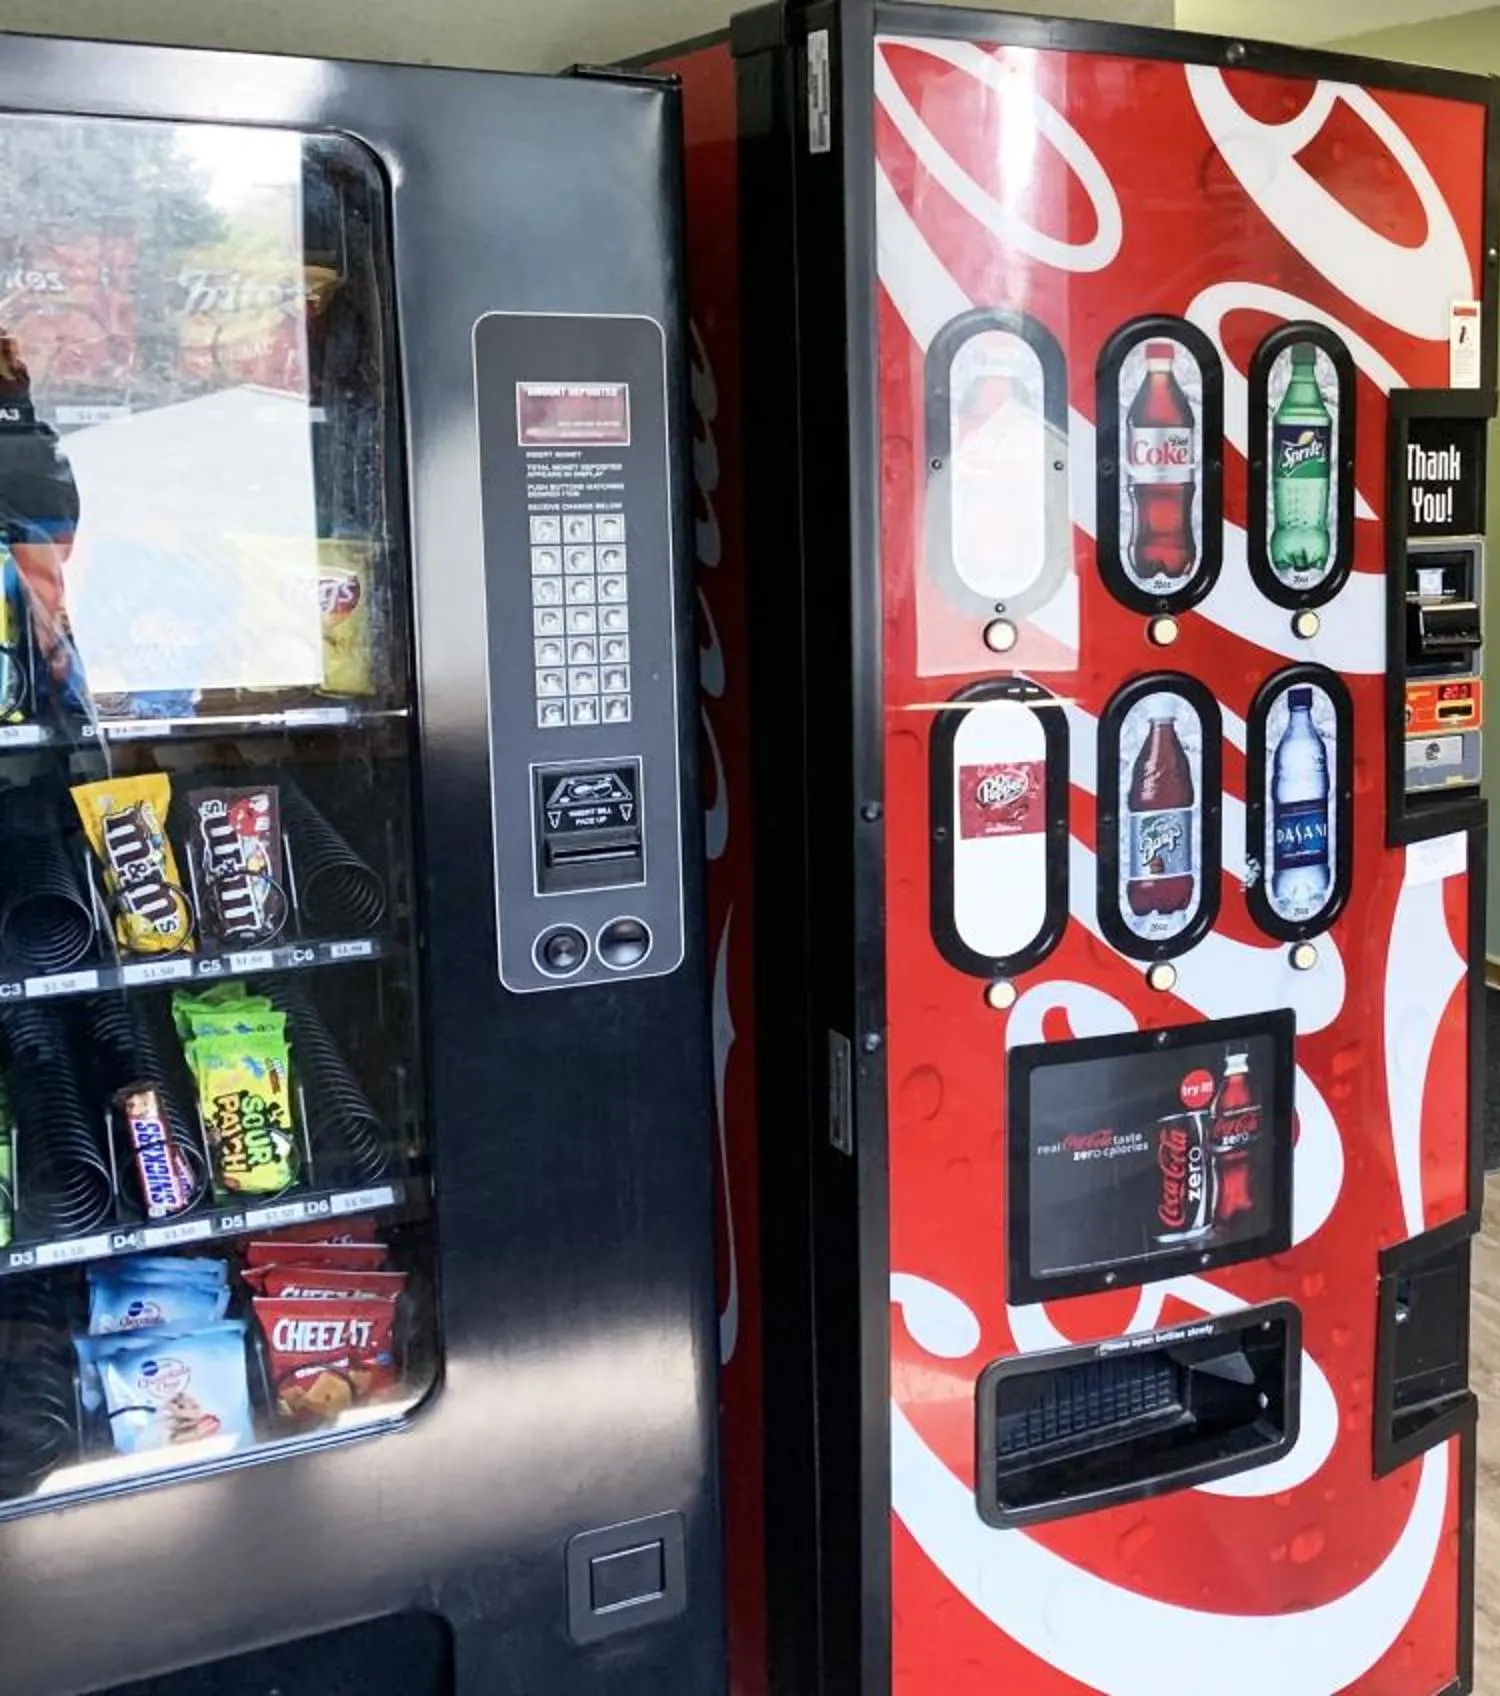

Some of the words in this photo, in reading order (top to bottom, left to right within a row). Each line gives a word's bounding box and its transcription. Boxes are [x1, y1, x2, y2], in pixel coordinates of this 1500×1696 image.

[1132, 439, 1188, 466] Coke
[1281, 439, 1323, 469] Sprite
[1407, 443, 1461, 481] Thank
[1411, 486, 1453, 524] You!
[1276, 823, 1327, 844] DASANI
[293, 950, 315, 962] C6
[199, 961, 222, 973] C5
[214, 1093, 249, 1173] PATCH
[241, 1094, 274, 1166] SOUR
[1221, 1130, 1250, 1146] zero
[1037, 1141, 1061, 1155] real
[1073, 1149, 1101, 1161] zero
[134, 1120, 178, 1205] SNICKERS
[1187, 1146, 1201, 1203] zero
[306, 1200, 329, 1213] D6
[221, 1215, 244, 1228] D5
[113, 1235, 136, 1248] D4
[10, 1252, 34, 1265] D3
[1187, 1323, 1214, 1337] slowly
